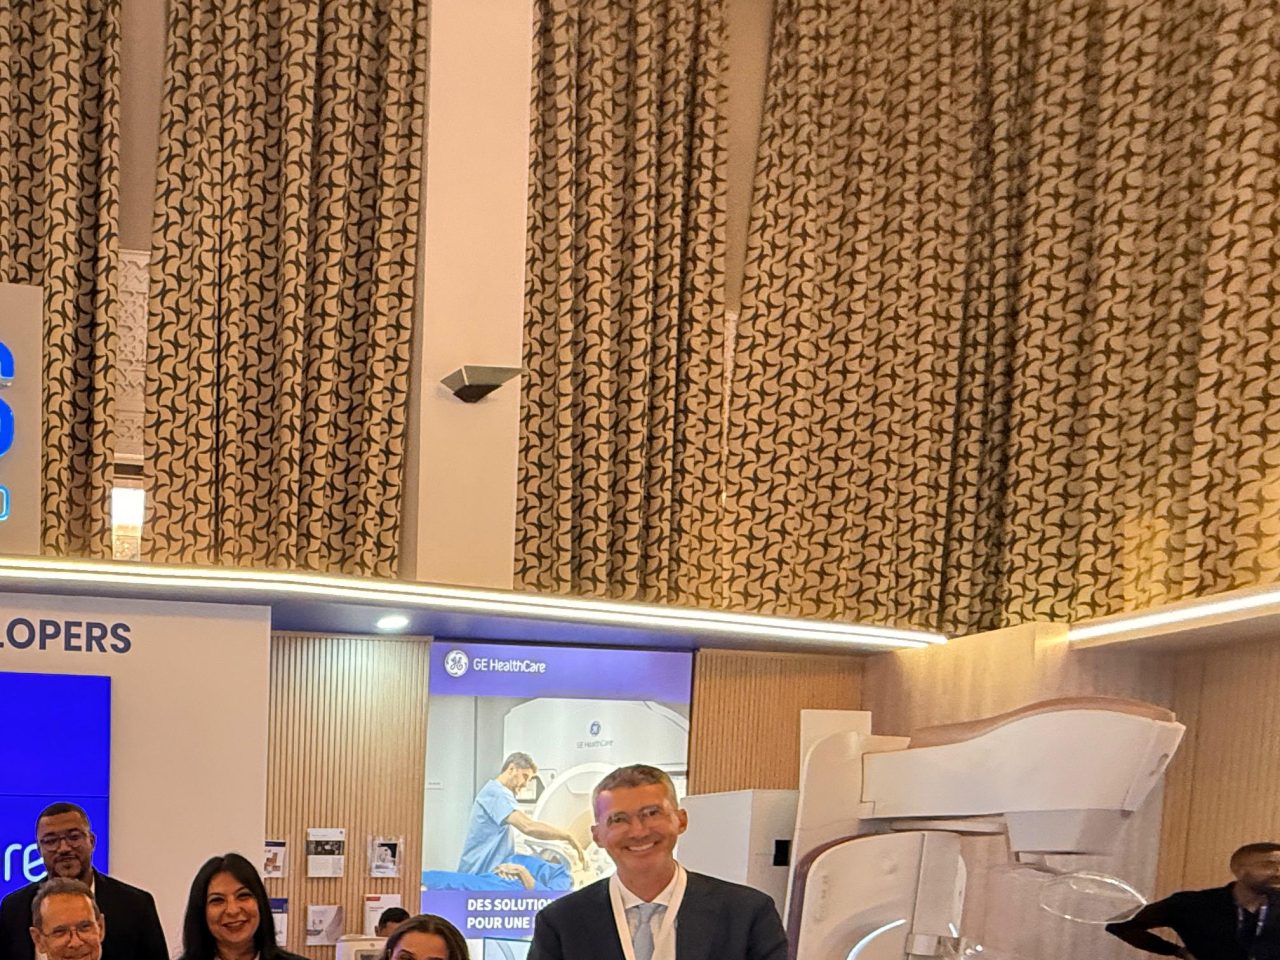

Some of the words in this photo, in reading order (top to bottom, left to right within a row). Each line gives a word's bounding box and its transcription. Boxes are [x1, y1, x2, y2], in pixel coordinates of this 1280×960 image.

[473, 658, 488, 671] GE
[489, 659, 546, 673] HealthCare
[467, 899, 492, 910] DES
[467, 917, 502, 928] POUR
[504, 917, 530, 928] UNE
